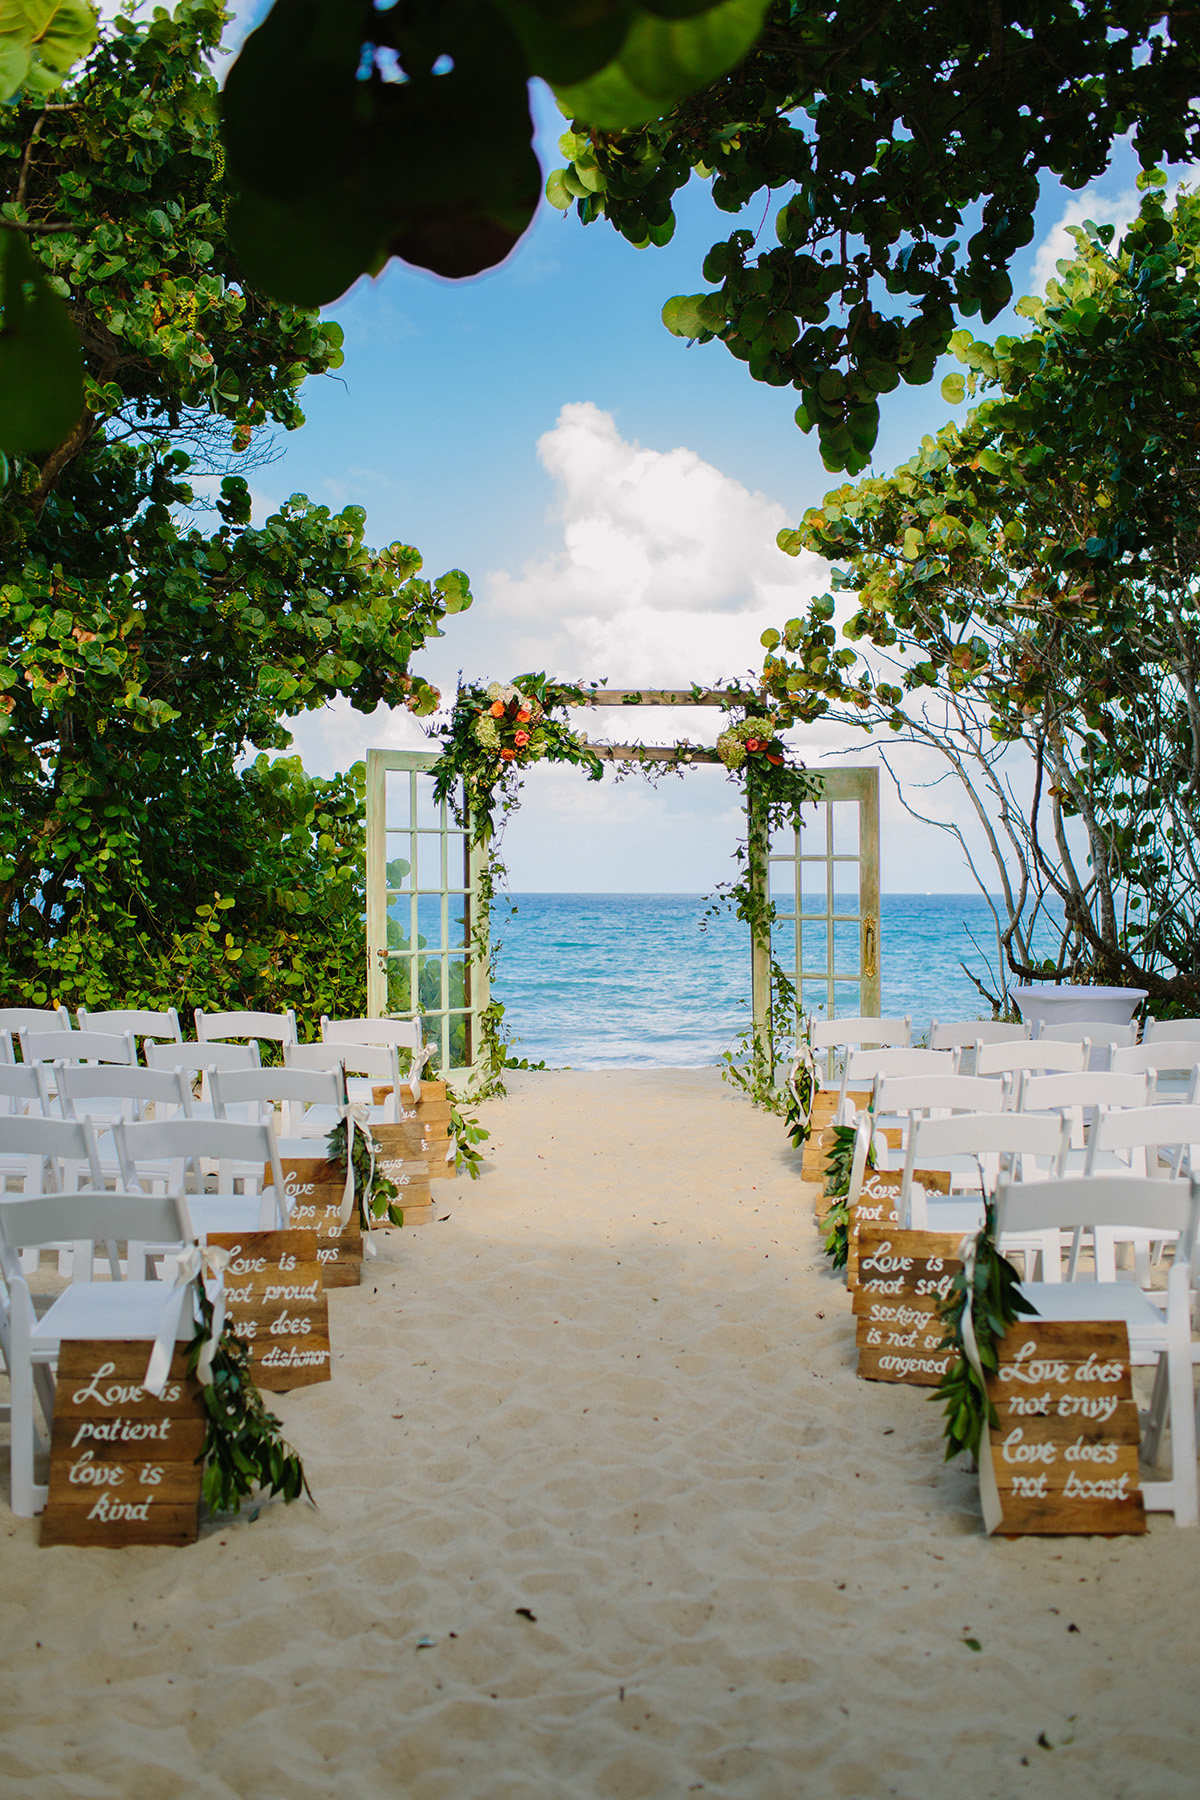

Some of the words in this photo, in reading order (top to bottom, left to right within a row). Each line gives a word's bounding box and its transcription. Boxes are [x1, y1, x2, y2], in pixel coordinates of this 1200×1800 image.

[855, 1204, 884, 1221] not
[278, 1252, 296, 1271] is
[862, 1241, 914, 1273] Love
[926, 1254, 944, 1272] is
[222, 1282, 254, 1303] not
[262, 1279, 319, 1305] proud
[863, 1275, 905, 1294] not
[270, 1309, 312, 1335] does
[869, 1303, 934, 1330] seeking
[866, 1327, 882, 1345] is
[886, 1329, 918, 1348] not
[261, 1345, 331, 1368] dishonor
[998, 1340, 1070, 1384] Love
[1074, 1352, 1125, 1383] does
[72, 1361, 145, 1407] Love
[157, 1379, 181, 1402] is
[1008, 1391, 1050, 1416] not
[1057, 1393, 1118, 1423] envy
[71, 1416, 171, 1448] patient
[1064, 1435, 1119, 1464] does
[139, 1462, 165, 1486] is
[1011, 1471, 1049, 1499] not
[1062, 1470, 1130, 1501] boast
[86, 1491, 154, 1523] kind
